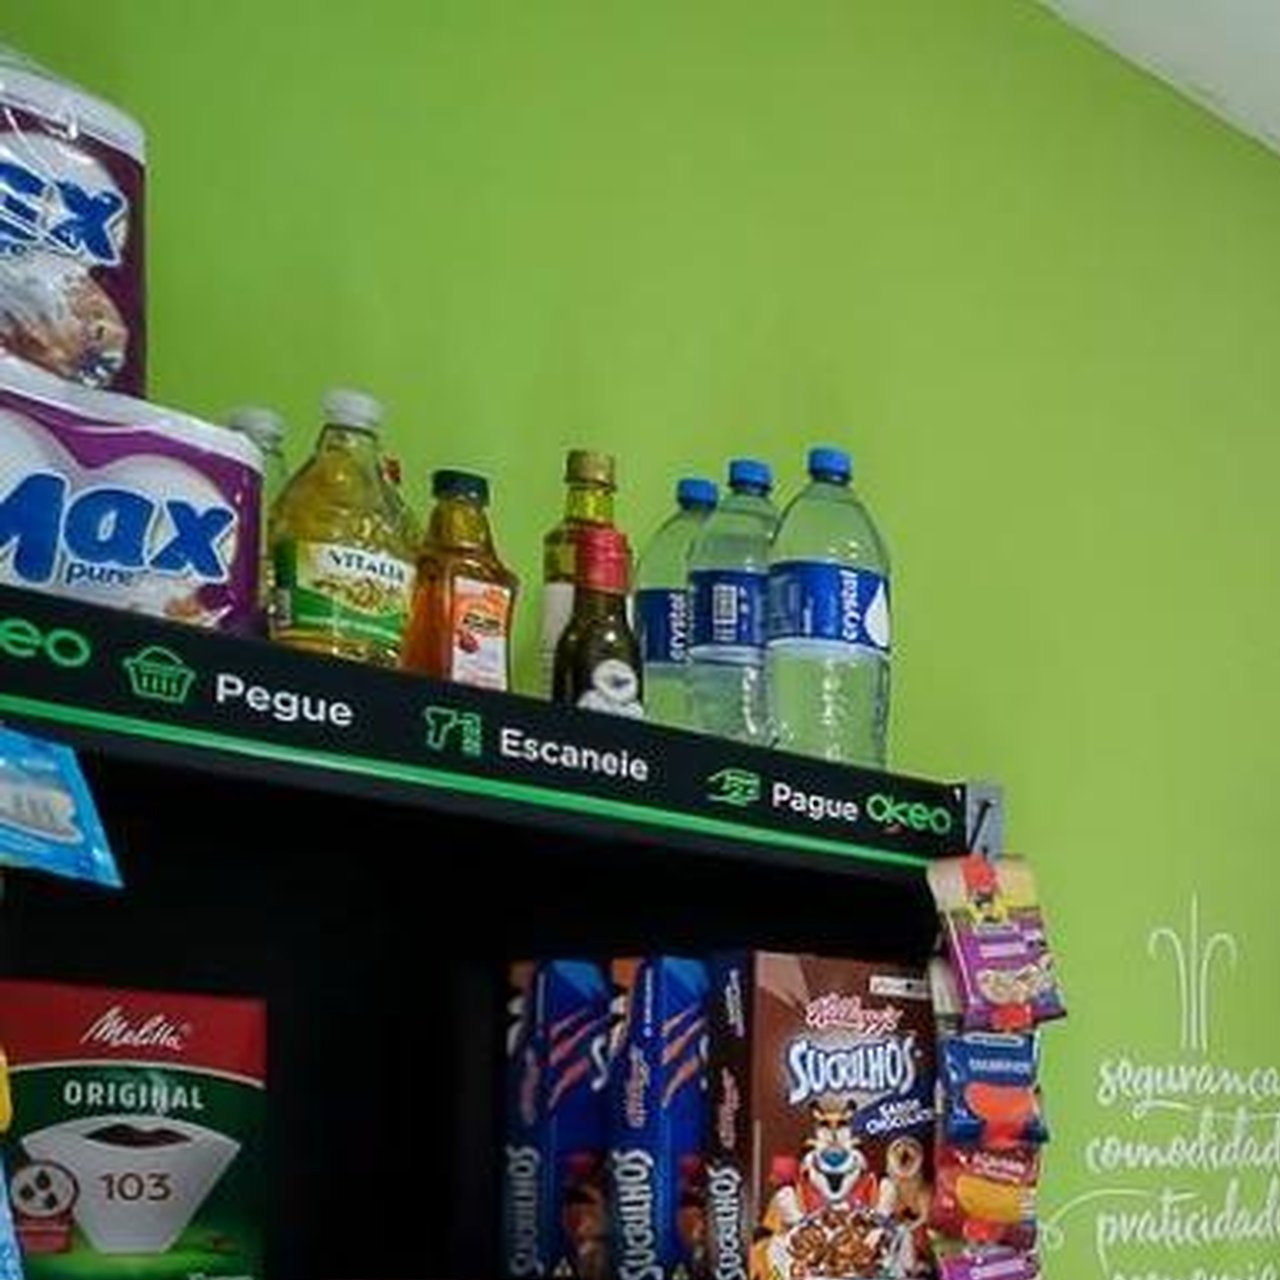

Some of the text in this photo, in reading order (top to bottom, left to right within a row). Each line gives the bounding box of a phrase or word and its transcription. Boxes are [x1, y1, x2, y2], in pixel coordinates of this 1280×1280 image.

[215, 673, 355, 727] Pegue
[499, 728, 650, 783] Escaneie
[771, 782, 859, 826] Pague
[80, 1004, 191, 1052] Melitta
[788, 1036, 915, 1104] SUCRILHOS
[63, 1080, 206, 1111] ORIGINAL
[100, 1173, 173, 1202] 103
